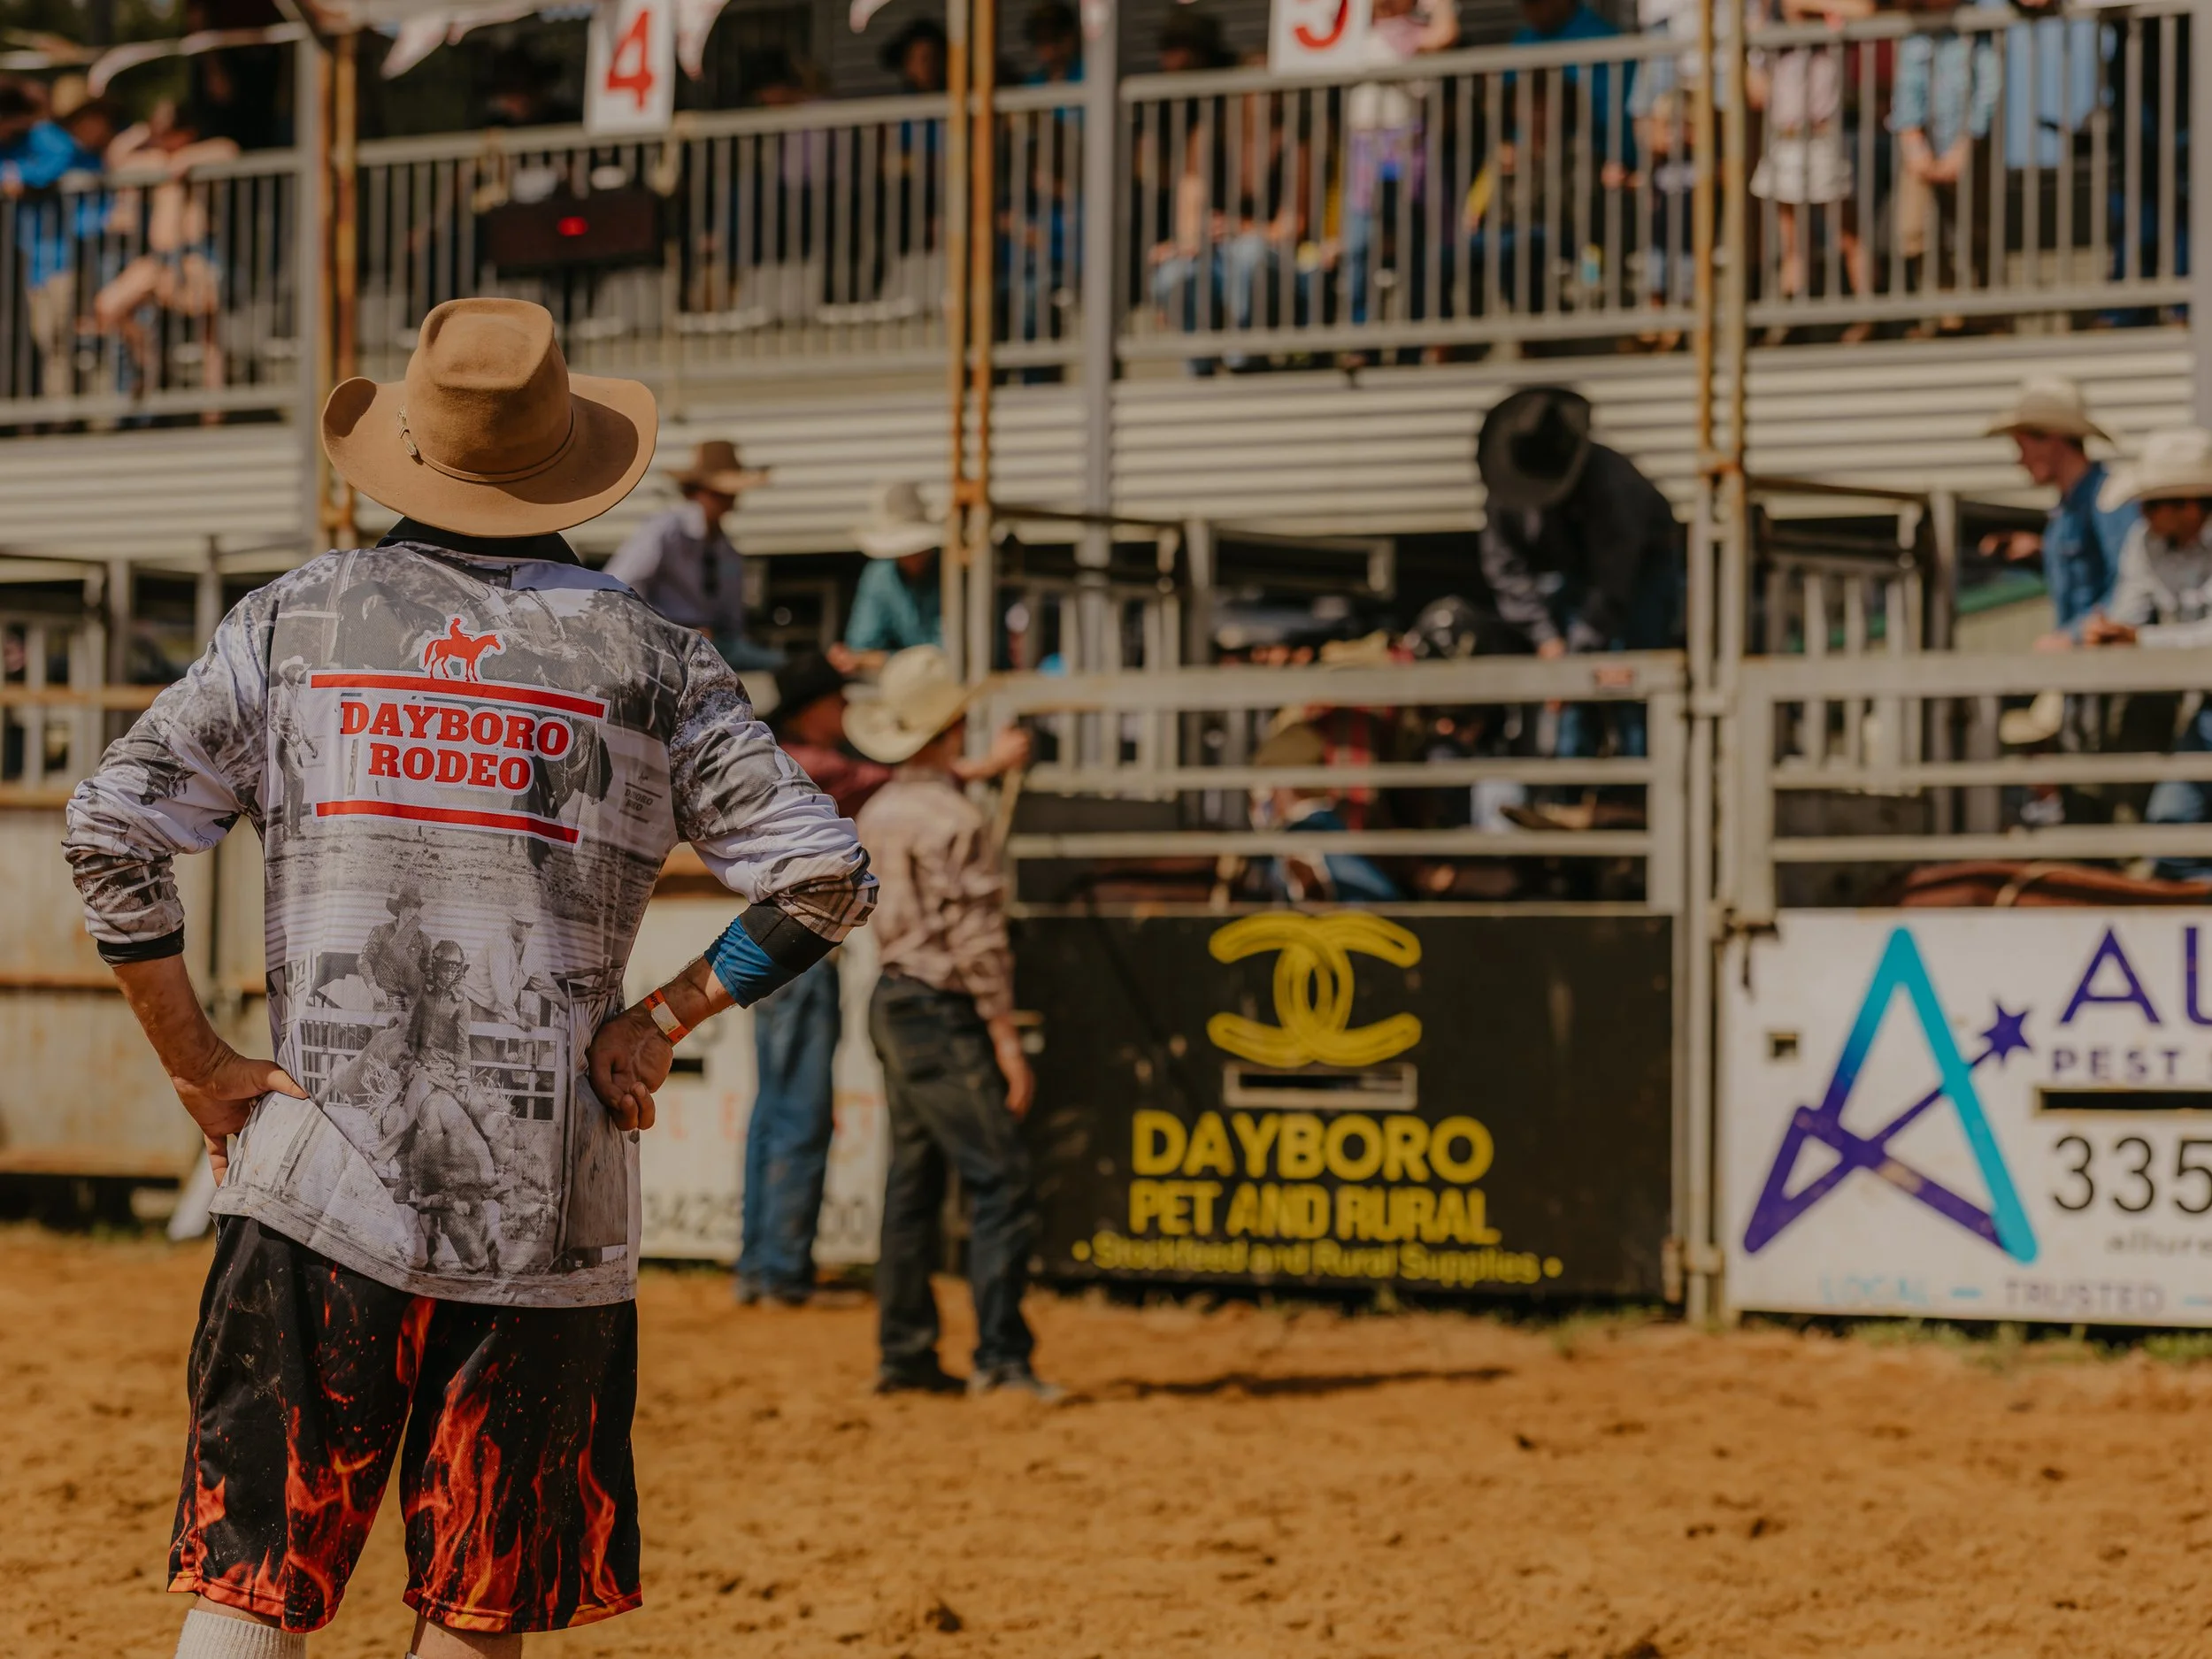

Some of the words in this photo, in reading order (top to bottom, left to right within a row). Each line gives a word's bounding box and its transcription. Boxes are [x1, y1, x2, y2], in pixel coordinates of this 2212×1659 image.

[607, 10, 653, 108] 4
[340, 701, 570, 756] DAYBORO
[368, 741, 531, 790] RODEO
[2052, 1048, 2180, 1079] PEST
[1131, 1110, 1494, 1184] DAYBORO
[2054, 1135, 2212, 1214] 335
[1129, 1181, 1223, 1235] PET
[1225, 1183, 1330, 1240] AND
[1335, 1187, 1502, 1245] RURAL
[1249, 1243, 1310, 1276] and
[2004, 1278, 2164, 1315] TRUSTED
